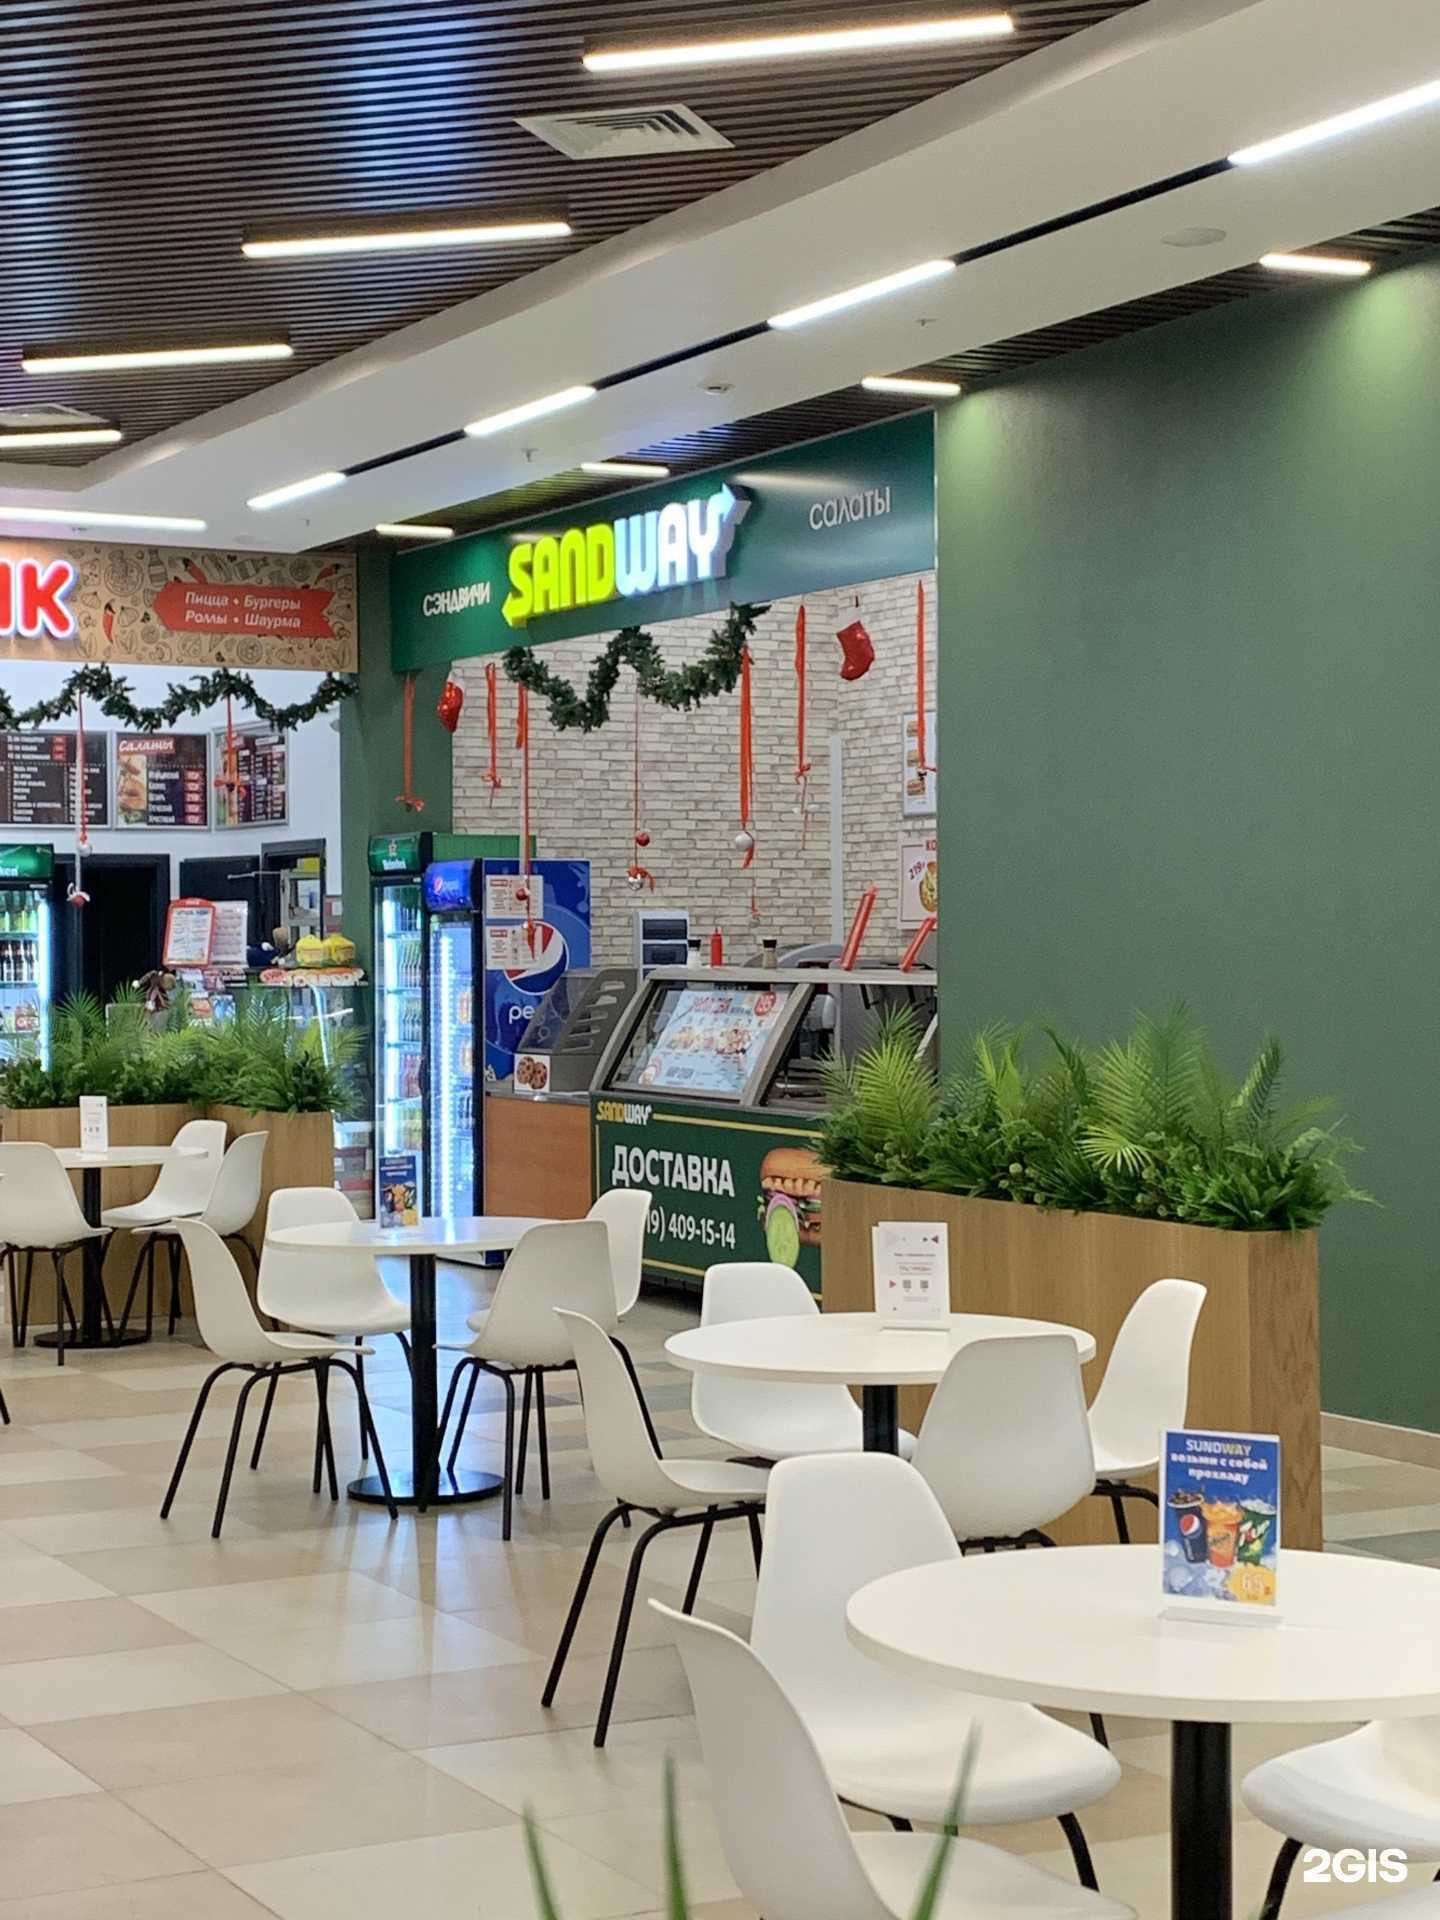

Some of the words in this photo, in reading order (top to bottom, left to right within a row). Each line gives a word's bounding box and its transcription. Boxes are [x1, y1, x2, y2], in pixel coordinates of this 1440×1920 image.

[502, 483, 737, 626] SANDWAY
[185, 591, 229, 606] Пицца
[244, 595, 301, 611] Бургеры
[244, 613, 301, 629] Шаурма
[508, 1005, 535, 1024] pe
[596, 1101, 652, 1126] SANDWAY
[612, 1145, 735, 1197] ДОСТАВКА
[668, 1213, 736, 1250] 409-15-14
[1171, 1453, 1218, 1466] возьми
[1220, 1458, 1227, 1467] с
[1228, 1457, 1268, 1471] собой
[1188, 1468, 1249, 1485] прохладу
